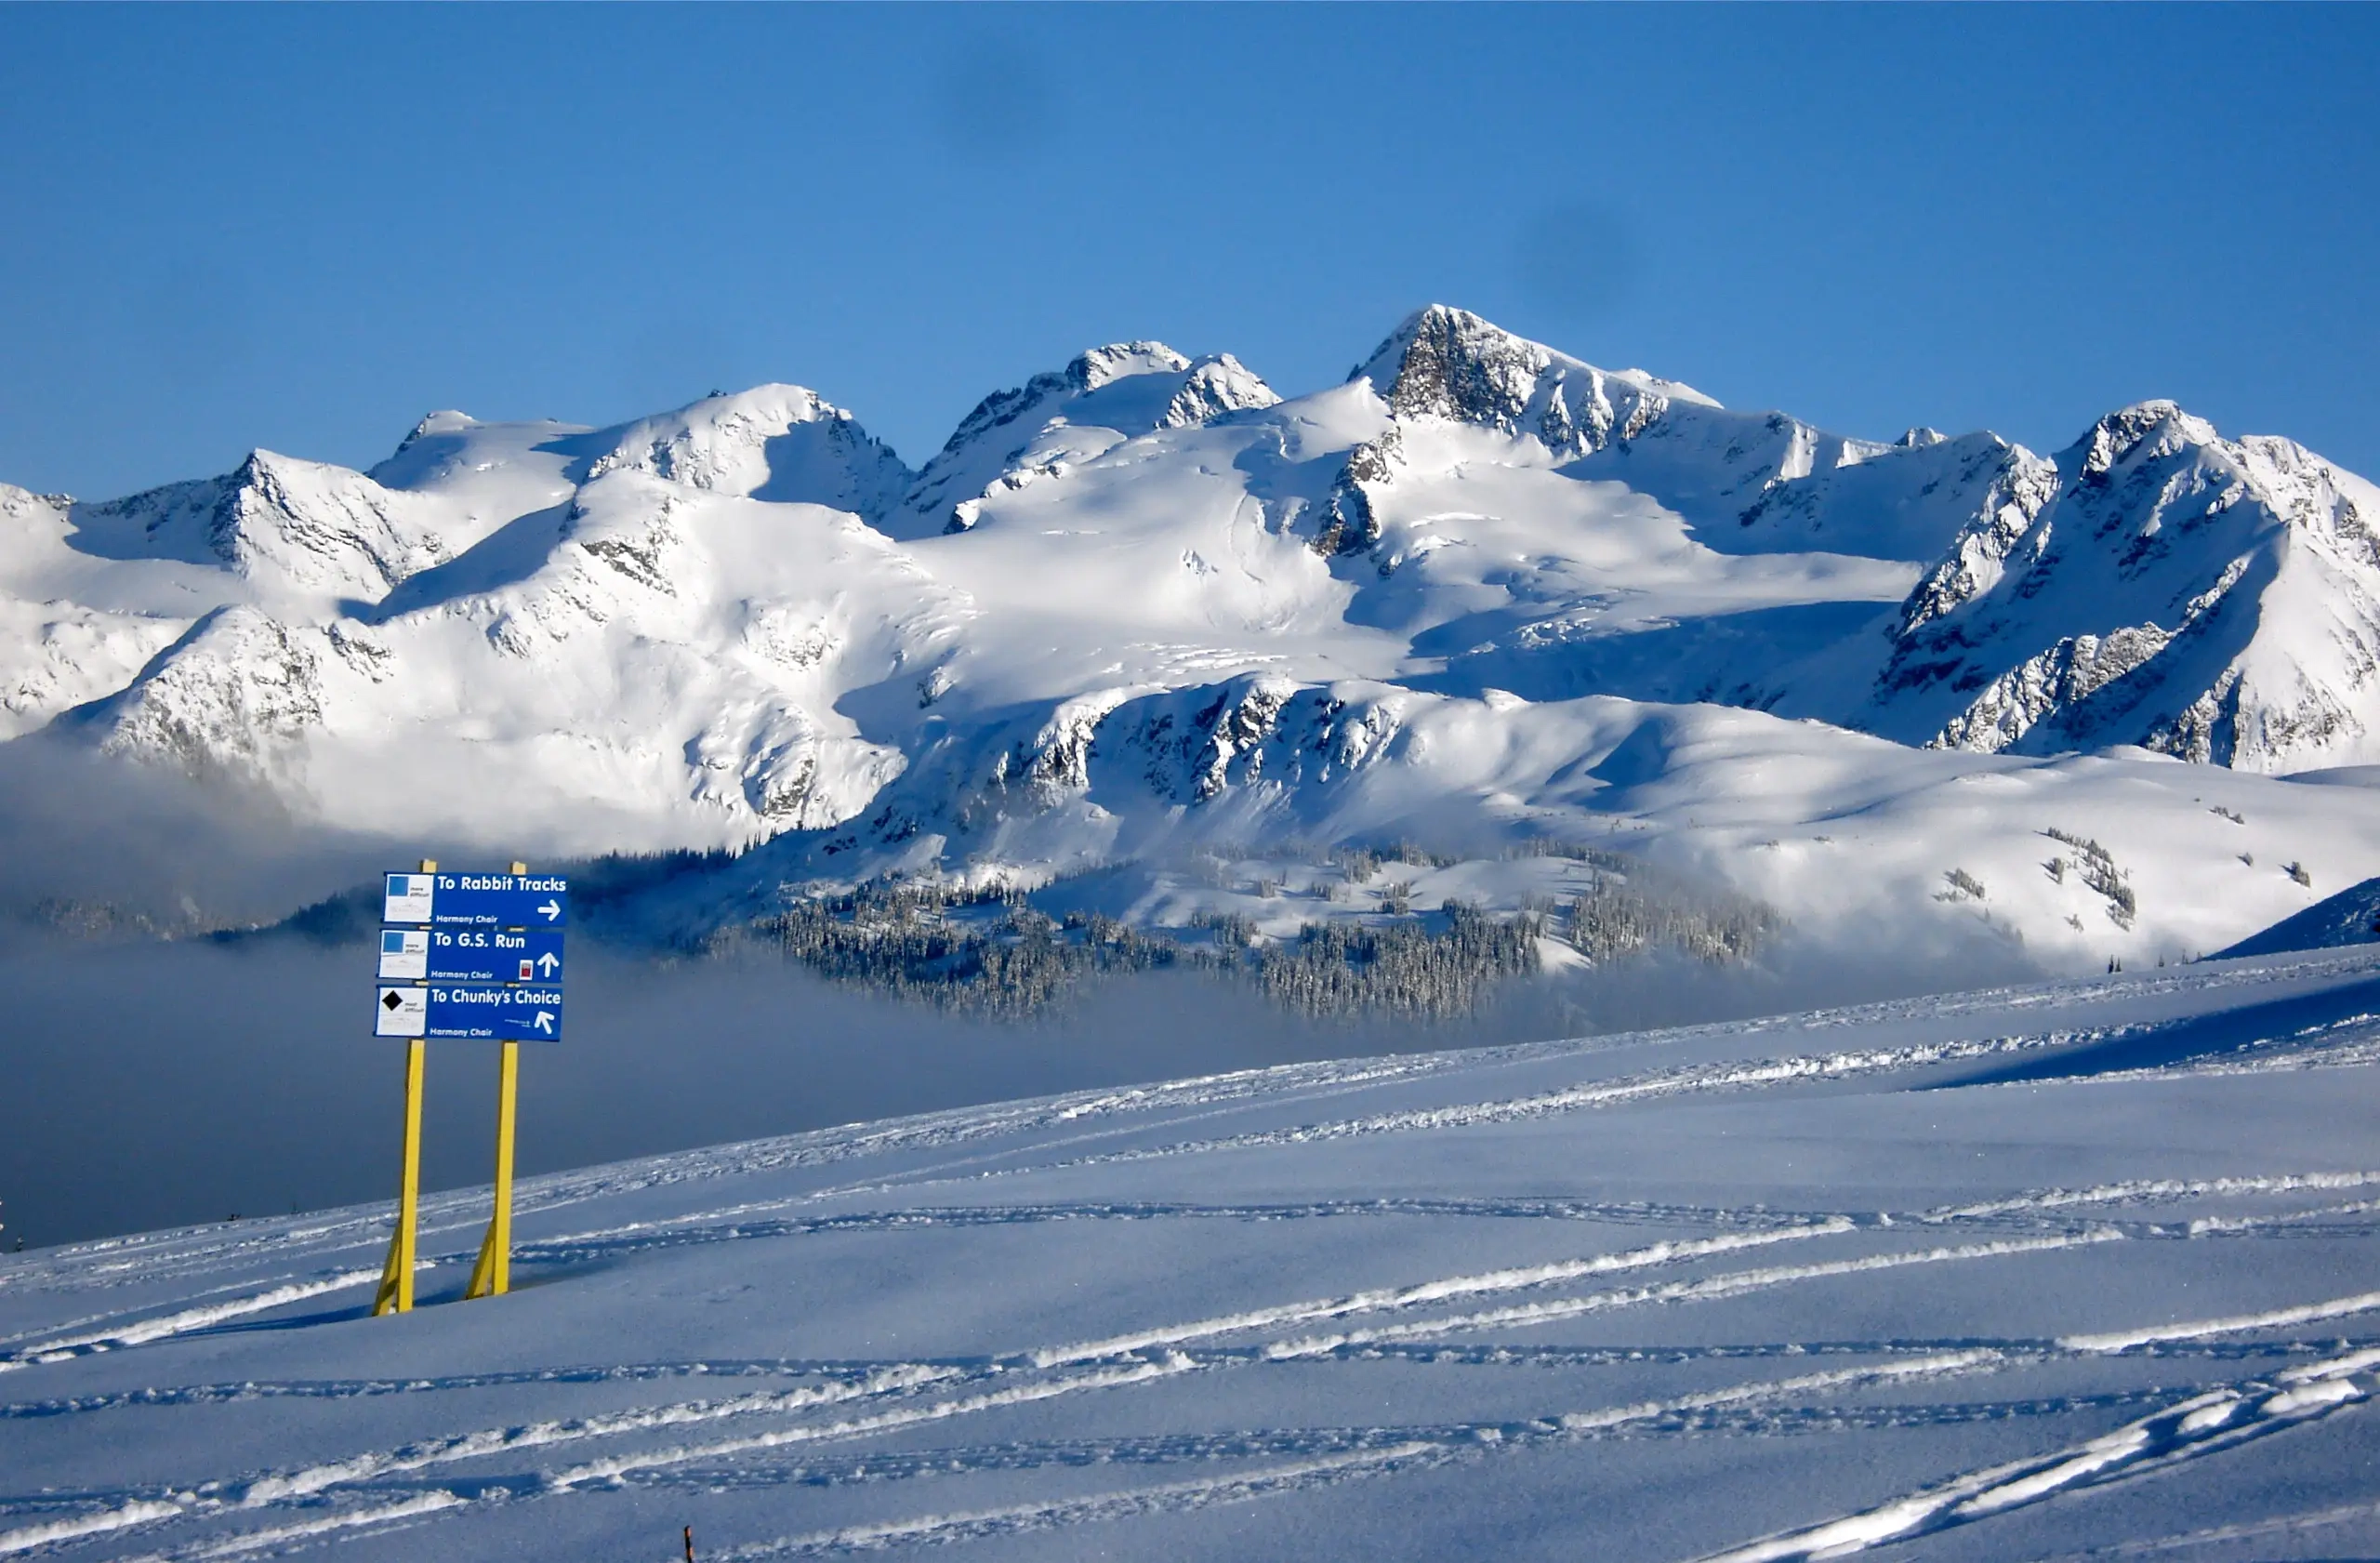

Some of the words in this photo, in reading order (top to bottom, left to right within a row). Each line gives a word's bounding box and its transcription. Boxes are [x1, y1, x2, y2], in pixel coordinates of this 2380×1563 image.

[437, 876, 456, 890] To
[461, 876, 513, 891] Rabbit
[517, 877, 566, 892] Tracks
[436, 915, 473, 924] Harmony
[475, 915, 498, 923] Chair
[433, 932, 452, 947] To
[457, 933, 489, 947] G.S.
[495, 934, 525, 948] Run
[430, 970, 469, 980] Harmony
[470, 971, 494, 979] Chair
[431, 988, 447, 1003] To
[451, 988, 510, 1007] Chunky's
[514, 989, 562, 1005] Choice
[430, 1027, 468, 1037] Harmony
[469, 1028, 493, 1037] Chair
